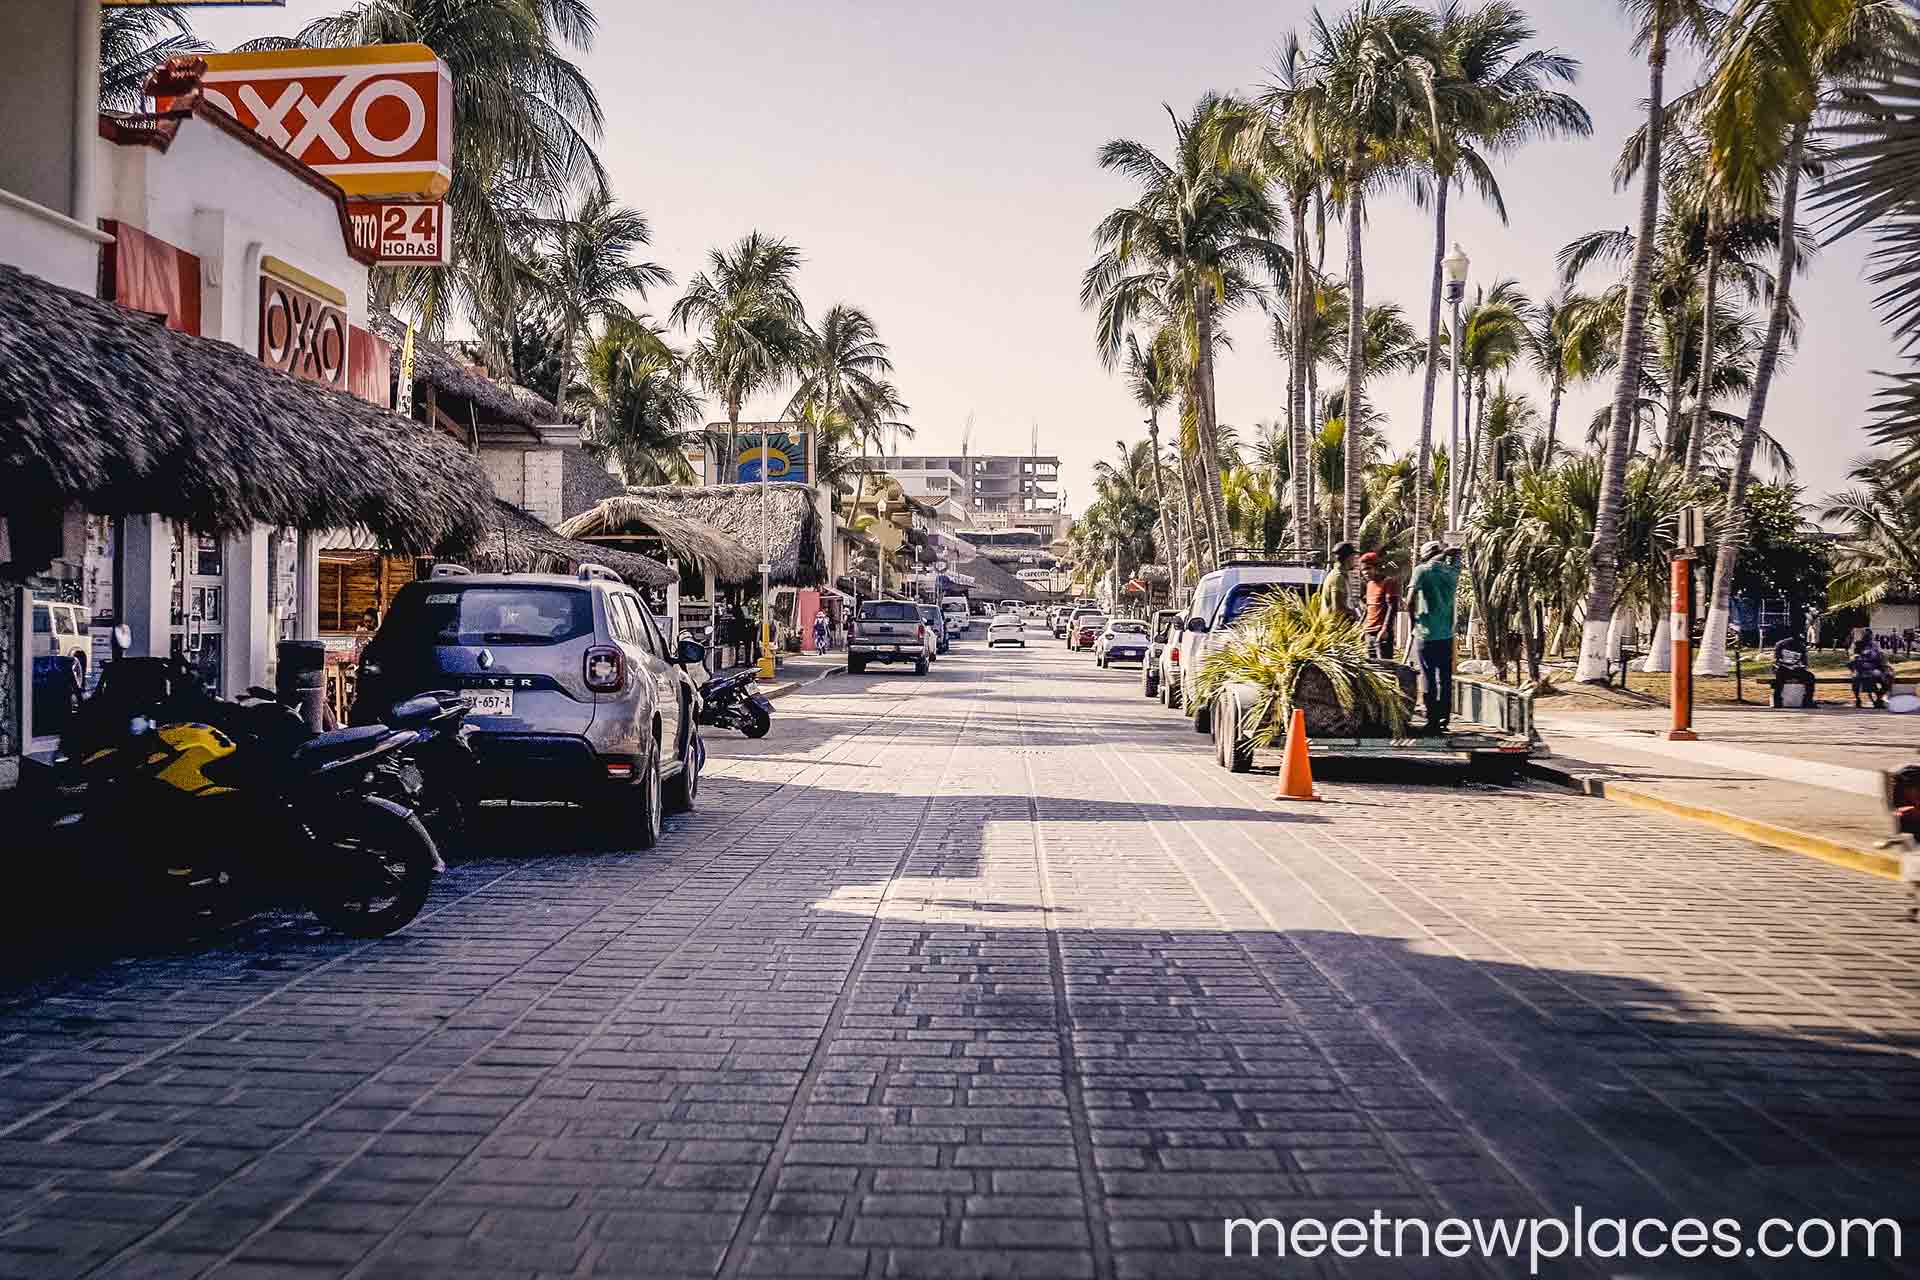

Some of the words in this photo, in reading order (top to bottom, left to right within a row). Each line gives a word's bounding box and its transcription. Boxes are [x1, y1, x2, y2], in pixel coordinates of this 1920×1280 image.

[202, 76, 426, 160] XXO
[382, 207, 436, 241] 24
[382, 242, 436, 255] HORAS
[267, 286, 344, 384] OXXO
